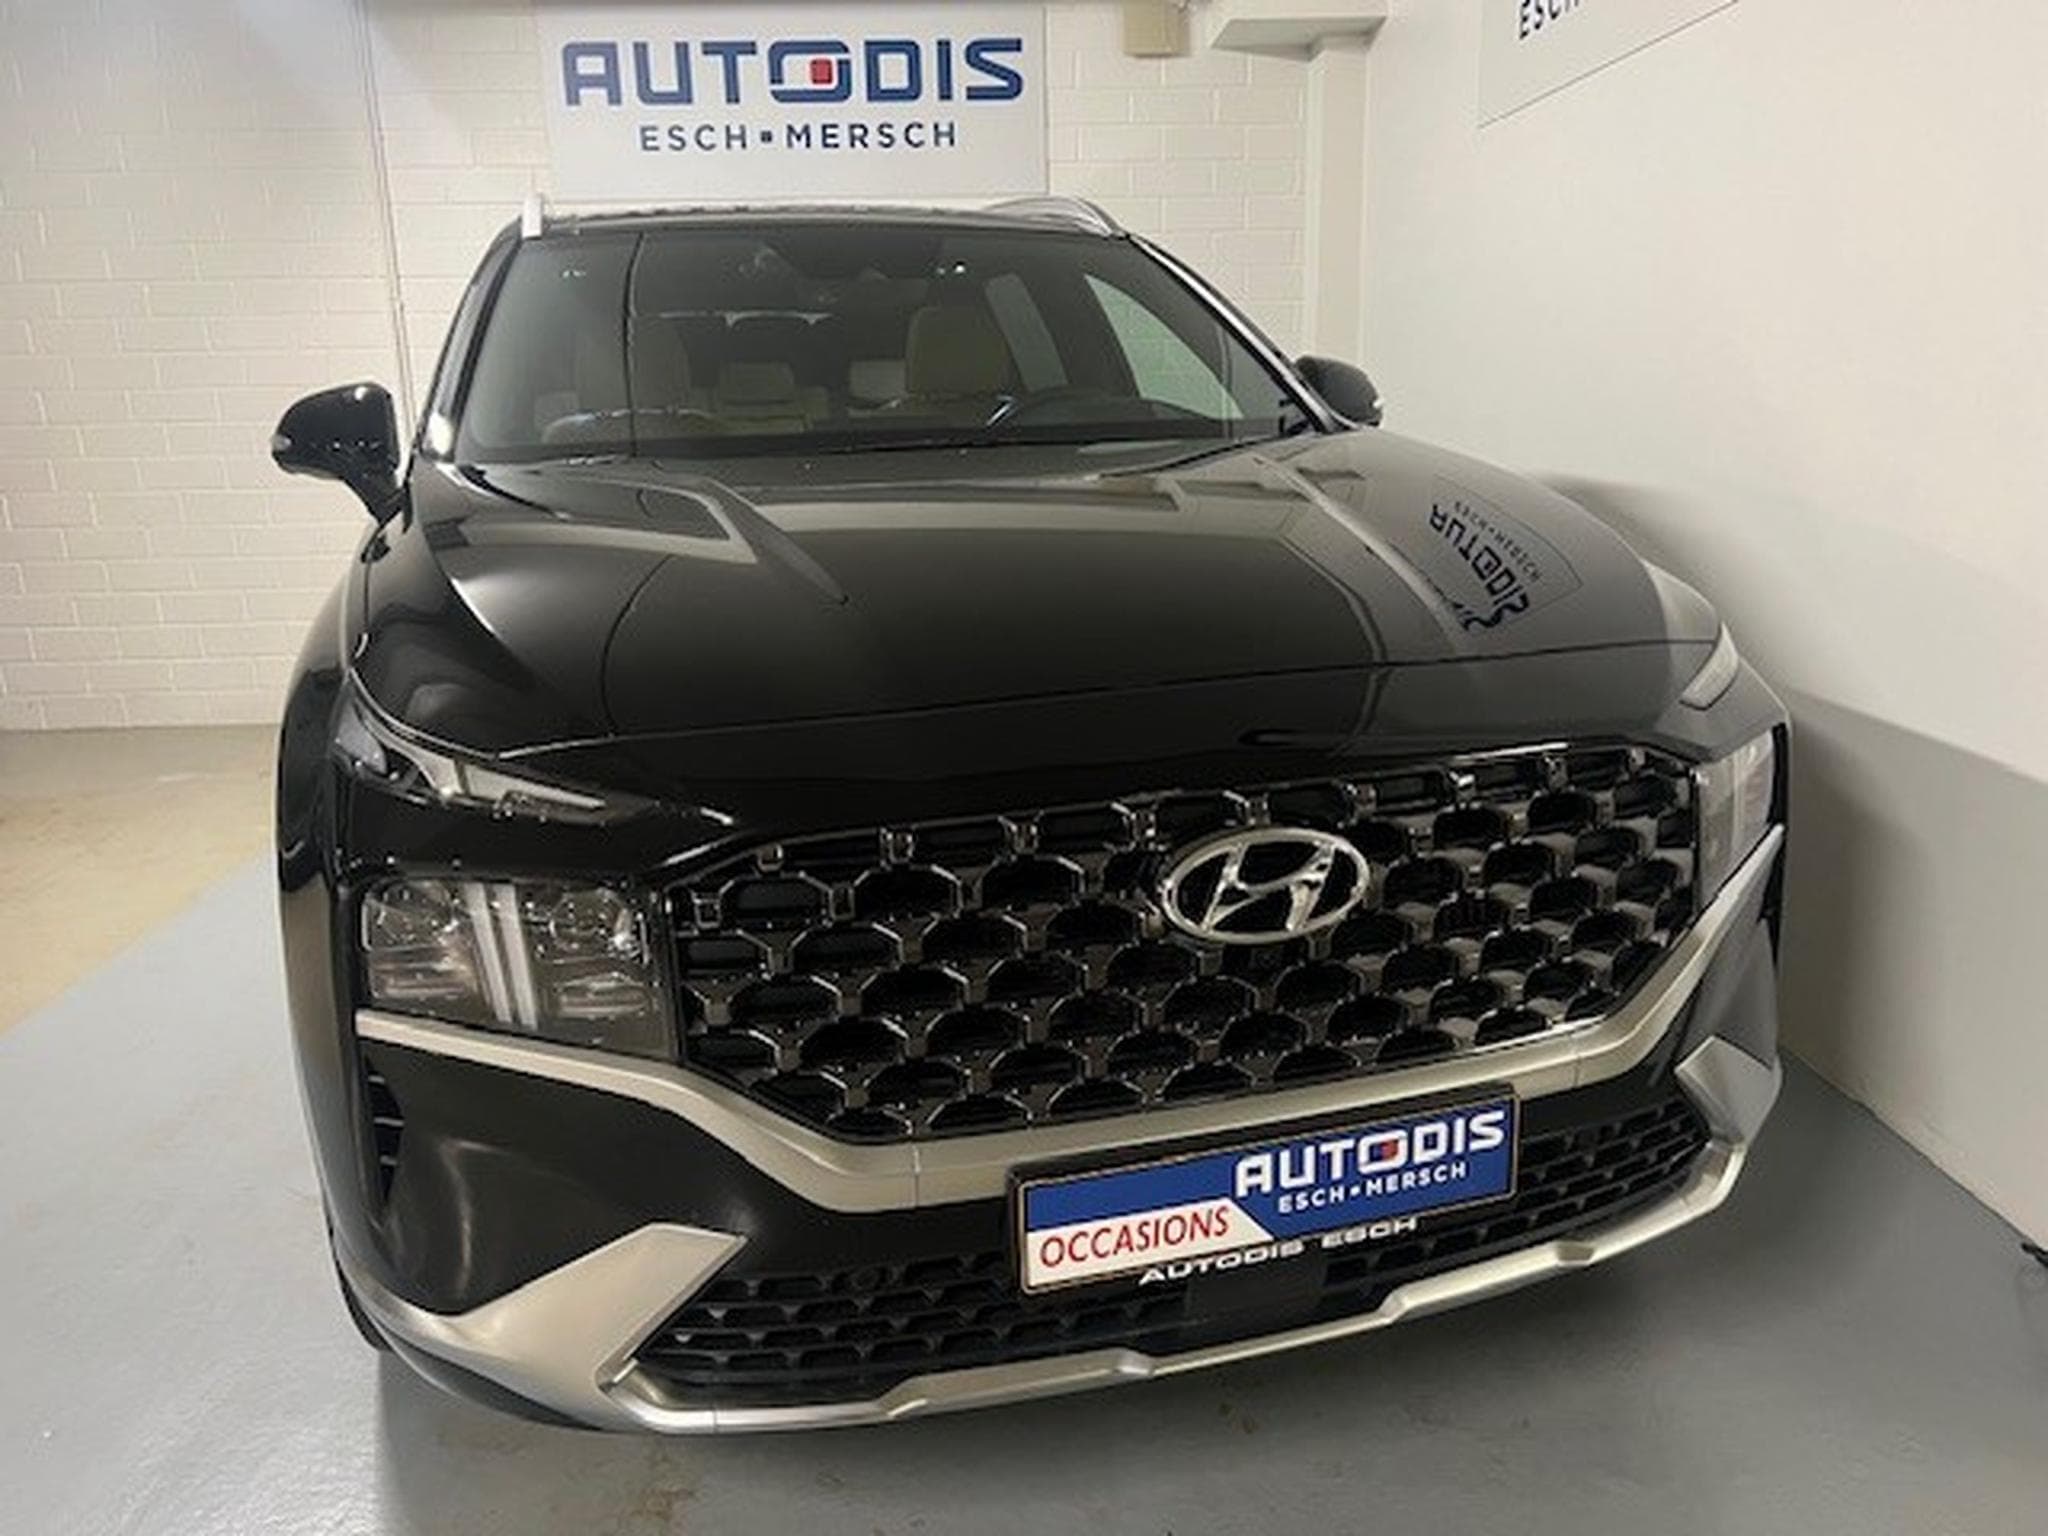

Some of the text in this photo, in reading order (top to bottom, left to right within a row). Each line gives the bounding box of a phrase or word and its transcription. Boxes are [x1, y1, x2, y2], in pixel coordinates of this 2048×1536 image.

[561, 37, 1024, 106] AUTODIS
[1235, 1110, 1505, 1198] AUTODIS
[1039, 1205, 1230, 1268] OCCASIONS
[1137, 1215, 1417, 1286] AUTODIS ESCH
